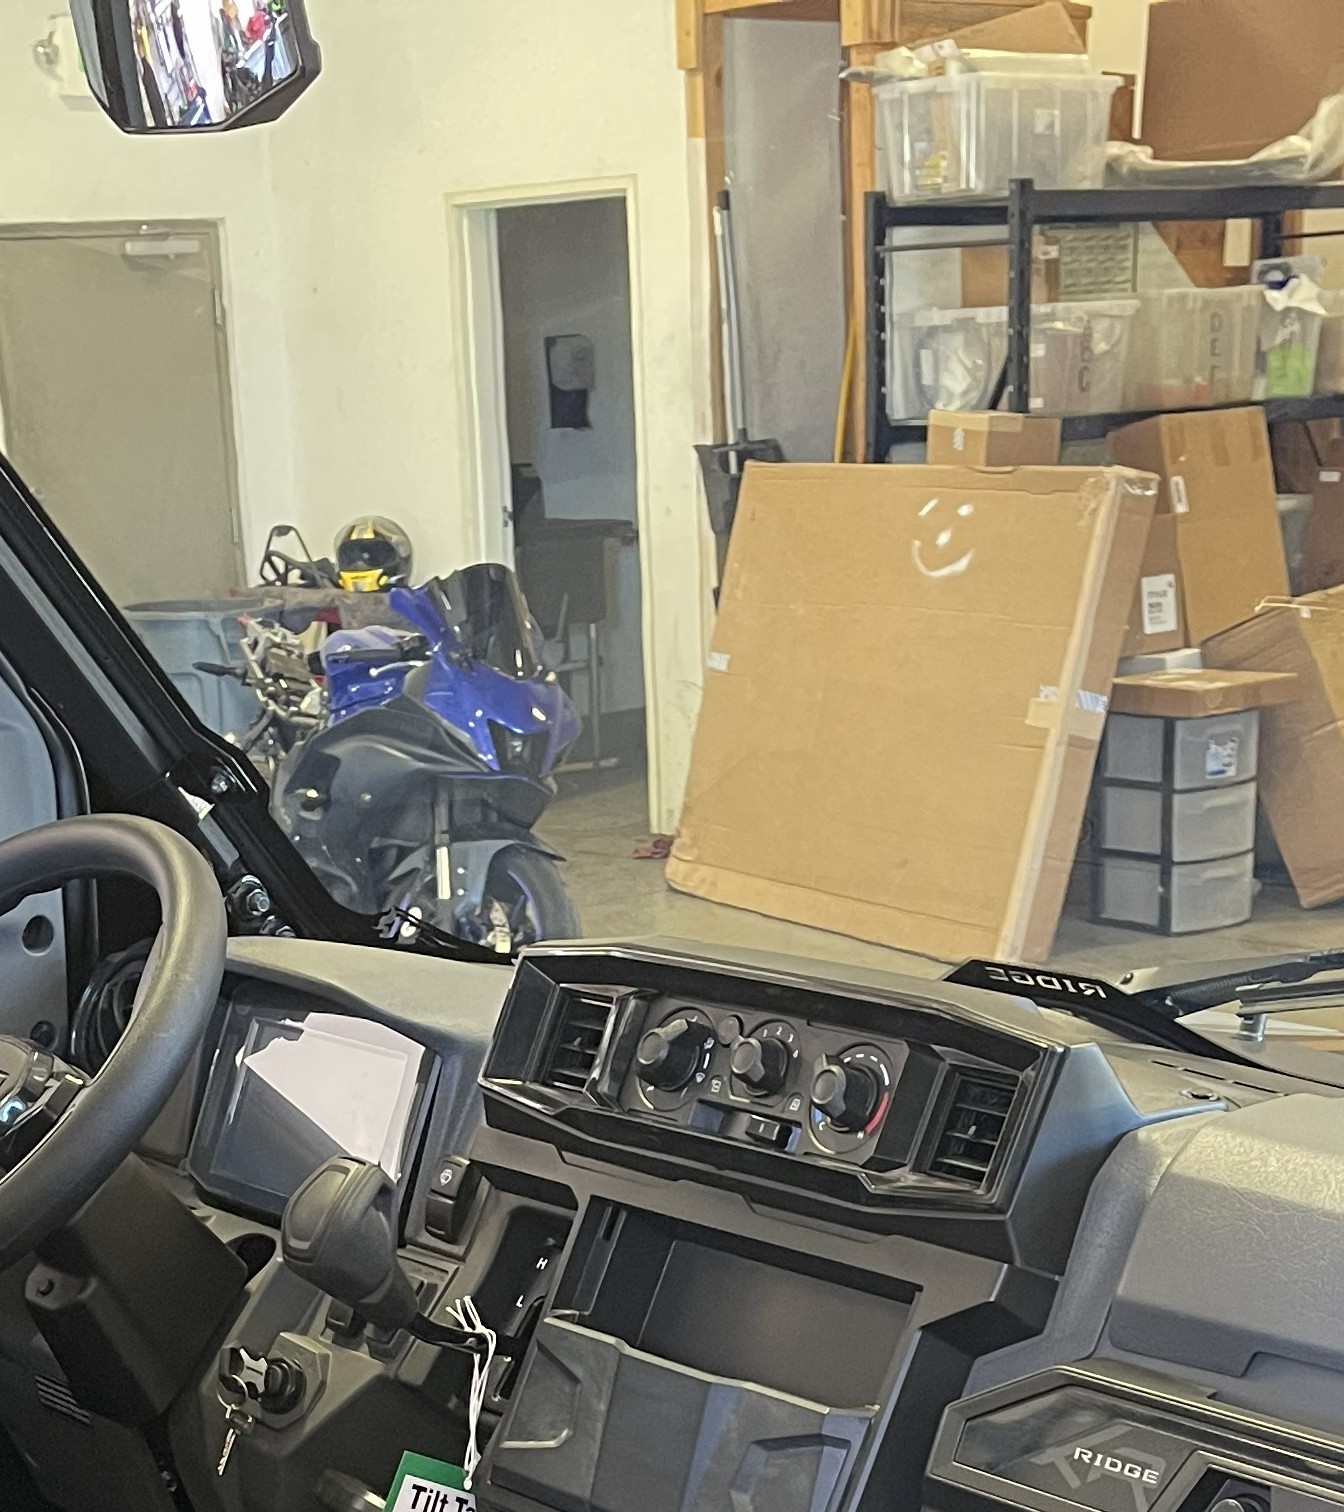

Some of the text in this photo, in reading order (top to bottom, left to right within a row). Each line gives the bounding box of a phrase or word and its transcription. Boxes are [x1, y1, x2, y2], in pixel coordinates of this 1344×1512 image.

[536, 1256, 549, 1271] H
[515, 1294, 524, 1308] L
[1073, 1447, 1160, 1485] RIDGE
